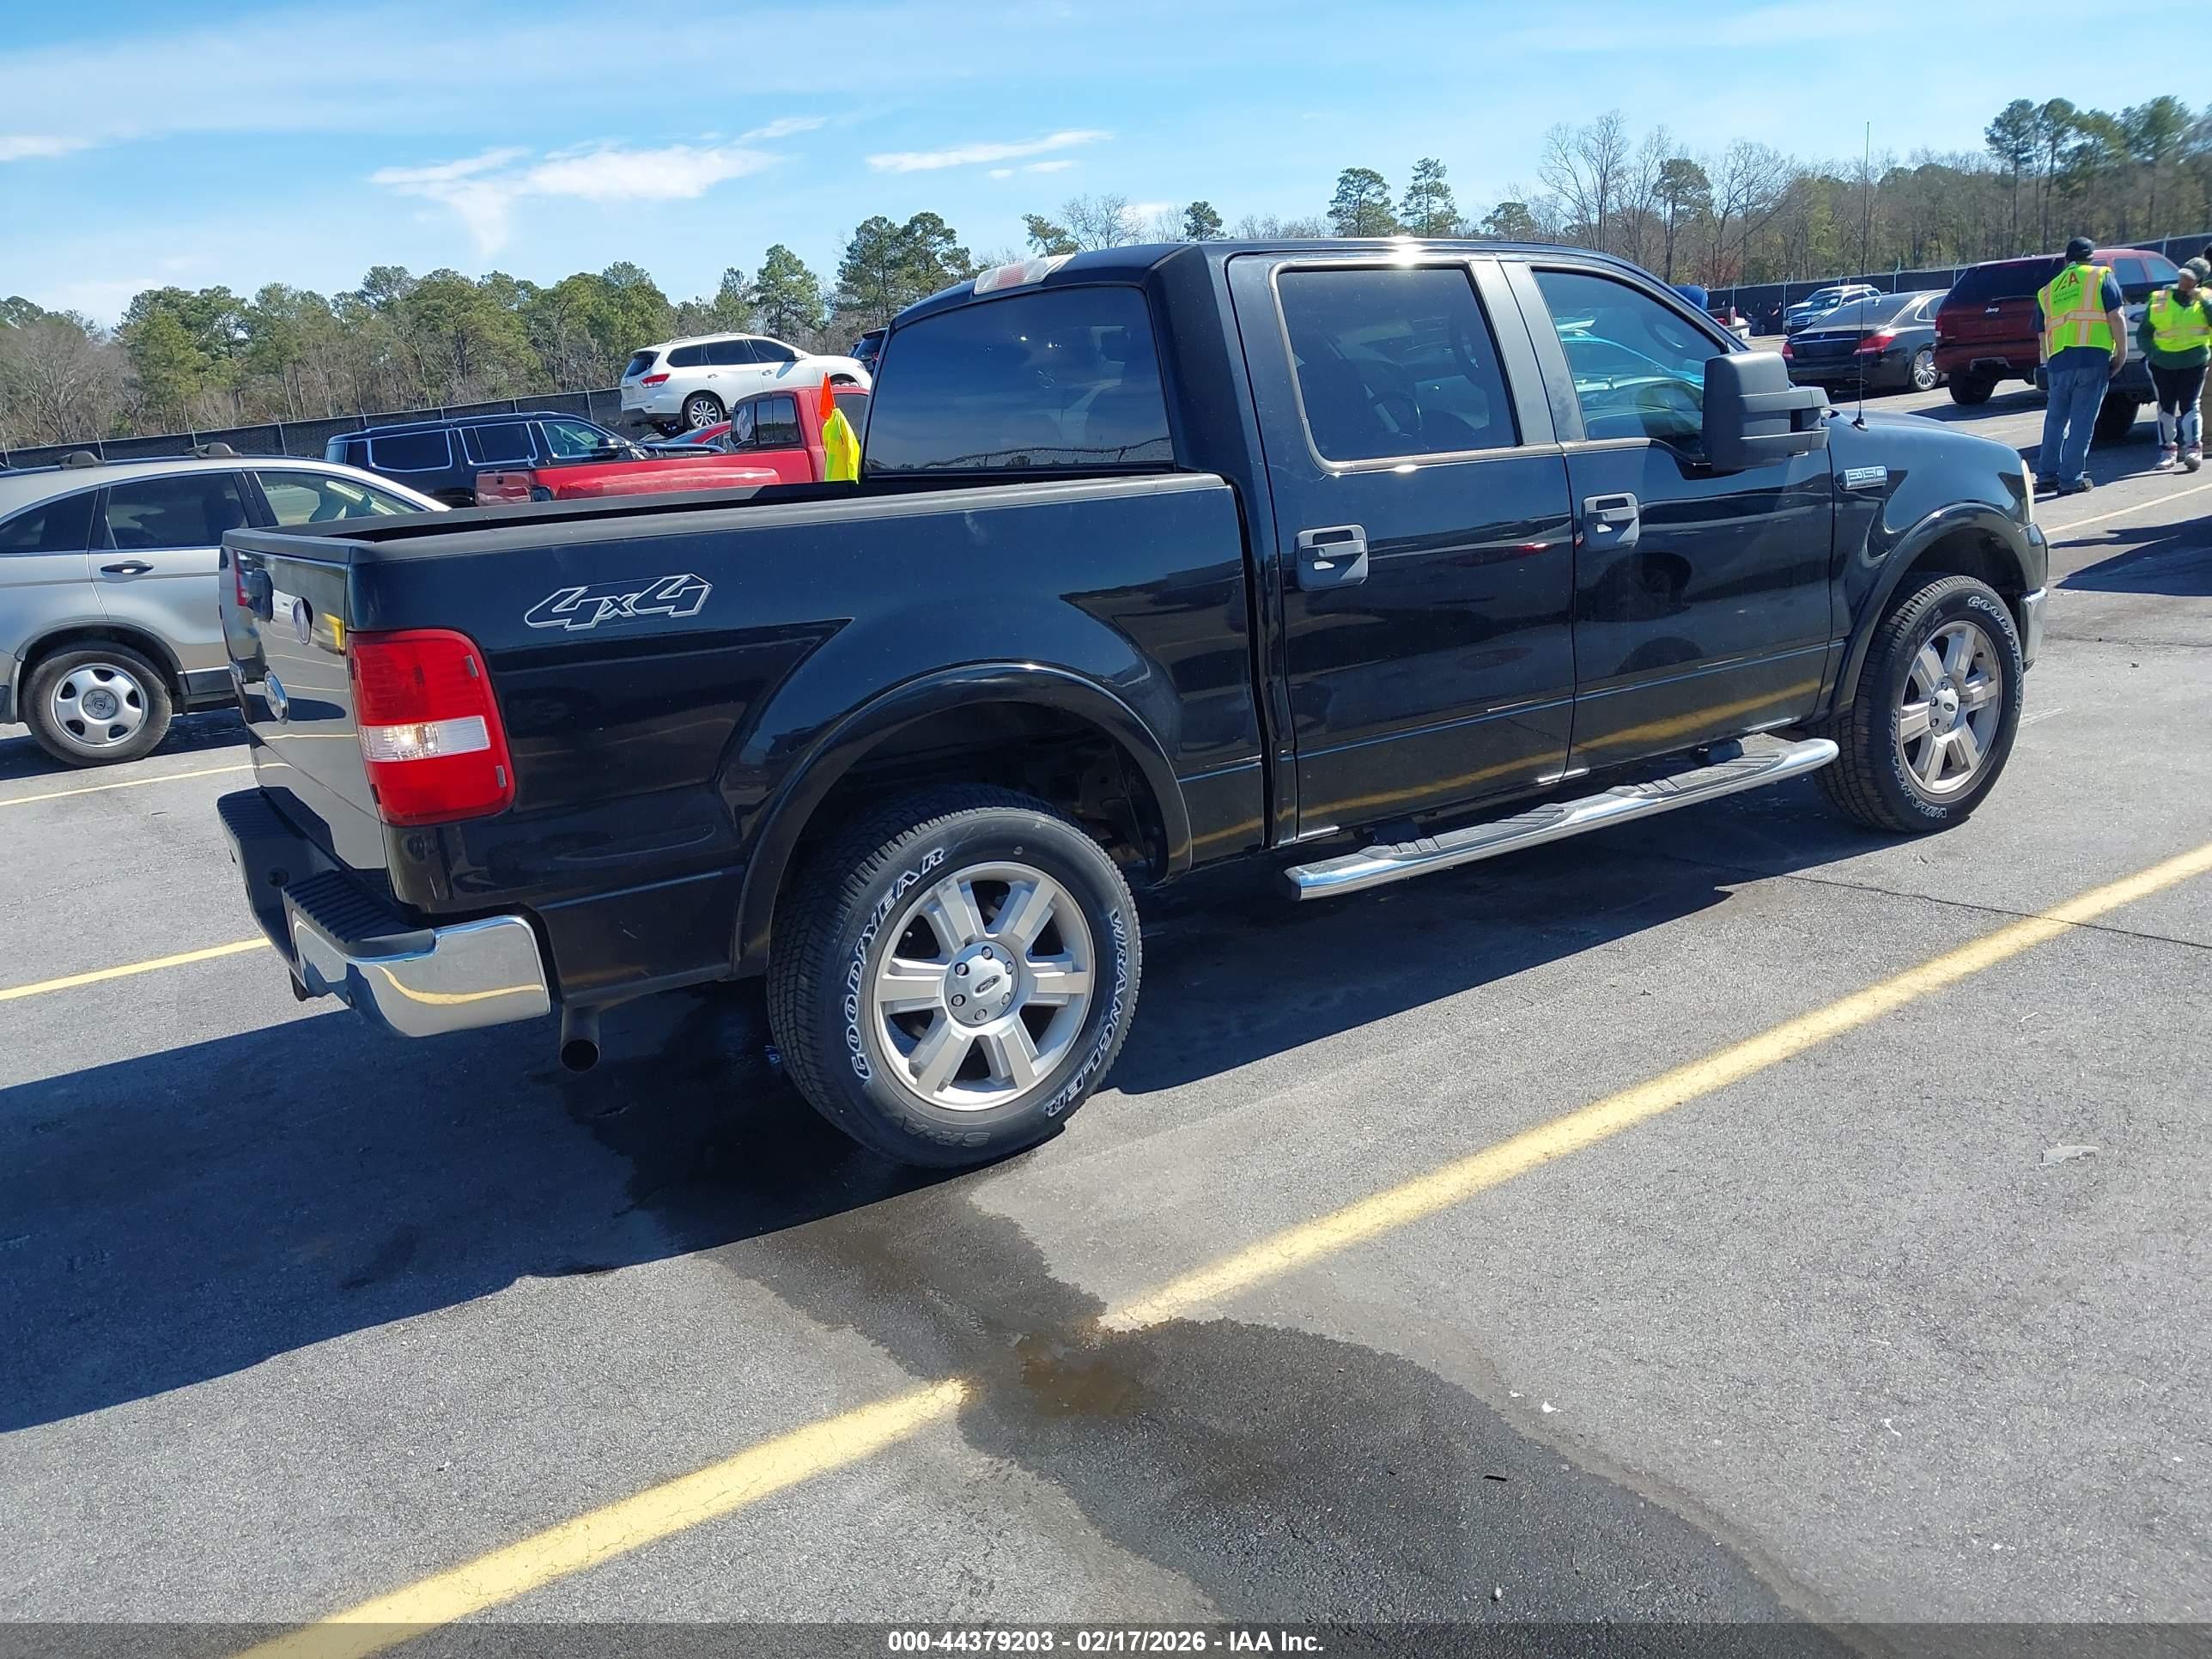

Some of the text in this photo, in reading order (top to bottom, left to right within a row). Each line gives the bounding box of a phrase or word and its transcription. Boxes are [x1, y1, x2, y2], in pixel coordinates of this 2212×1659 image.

[525, 574, 712, 631] 4x4
[1889, 708, 1948, 818] WRANGLER
[845, 848, 945, 1079] GOODYEAR
[1044, 908, 1129, 1116] WRANGLER
